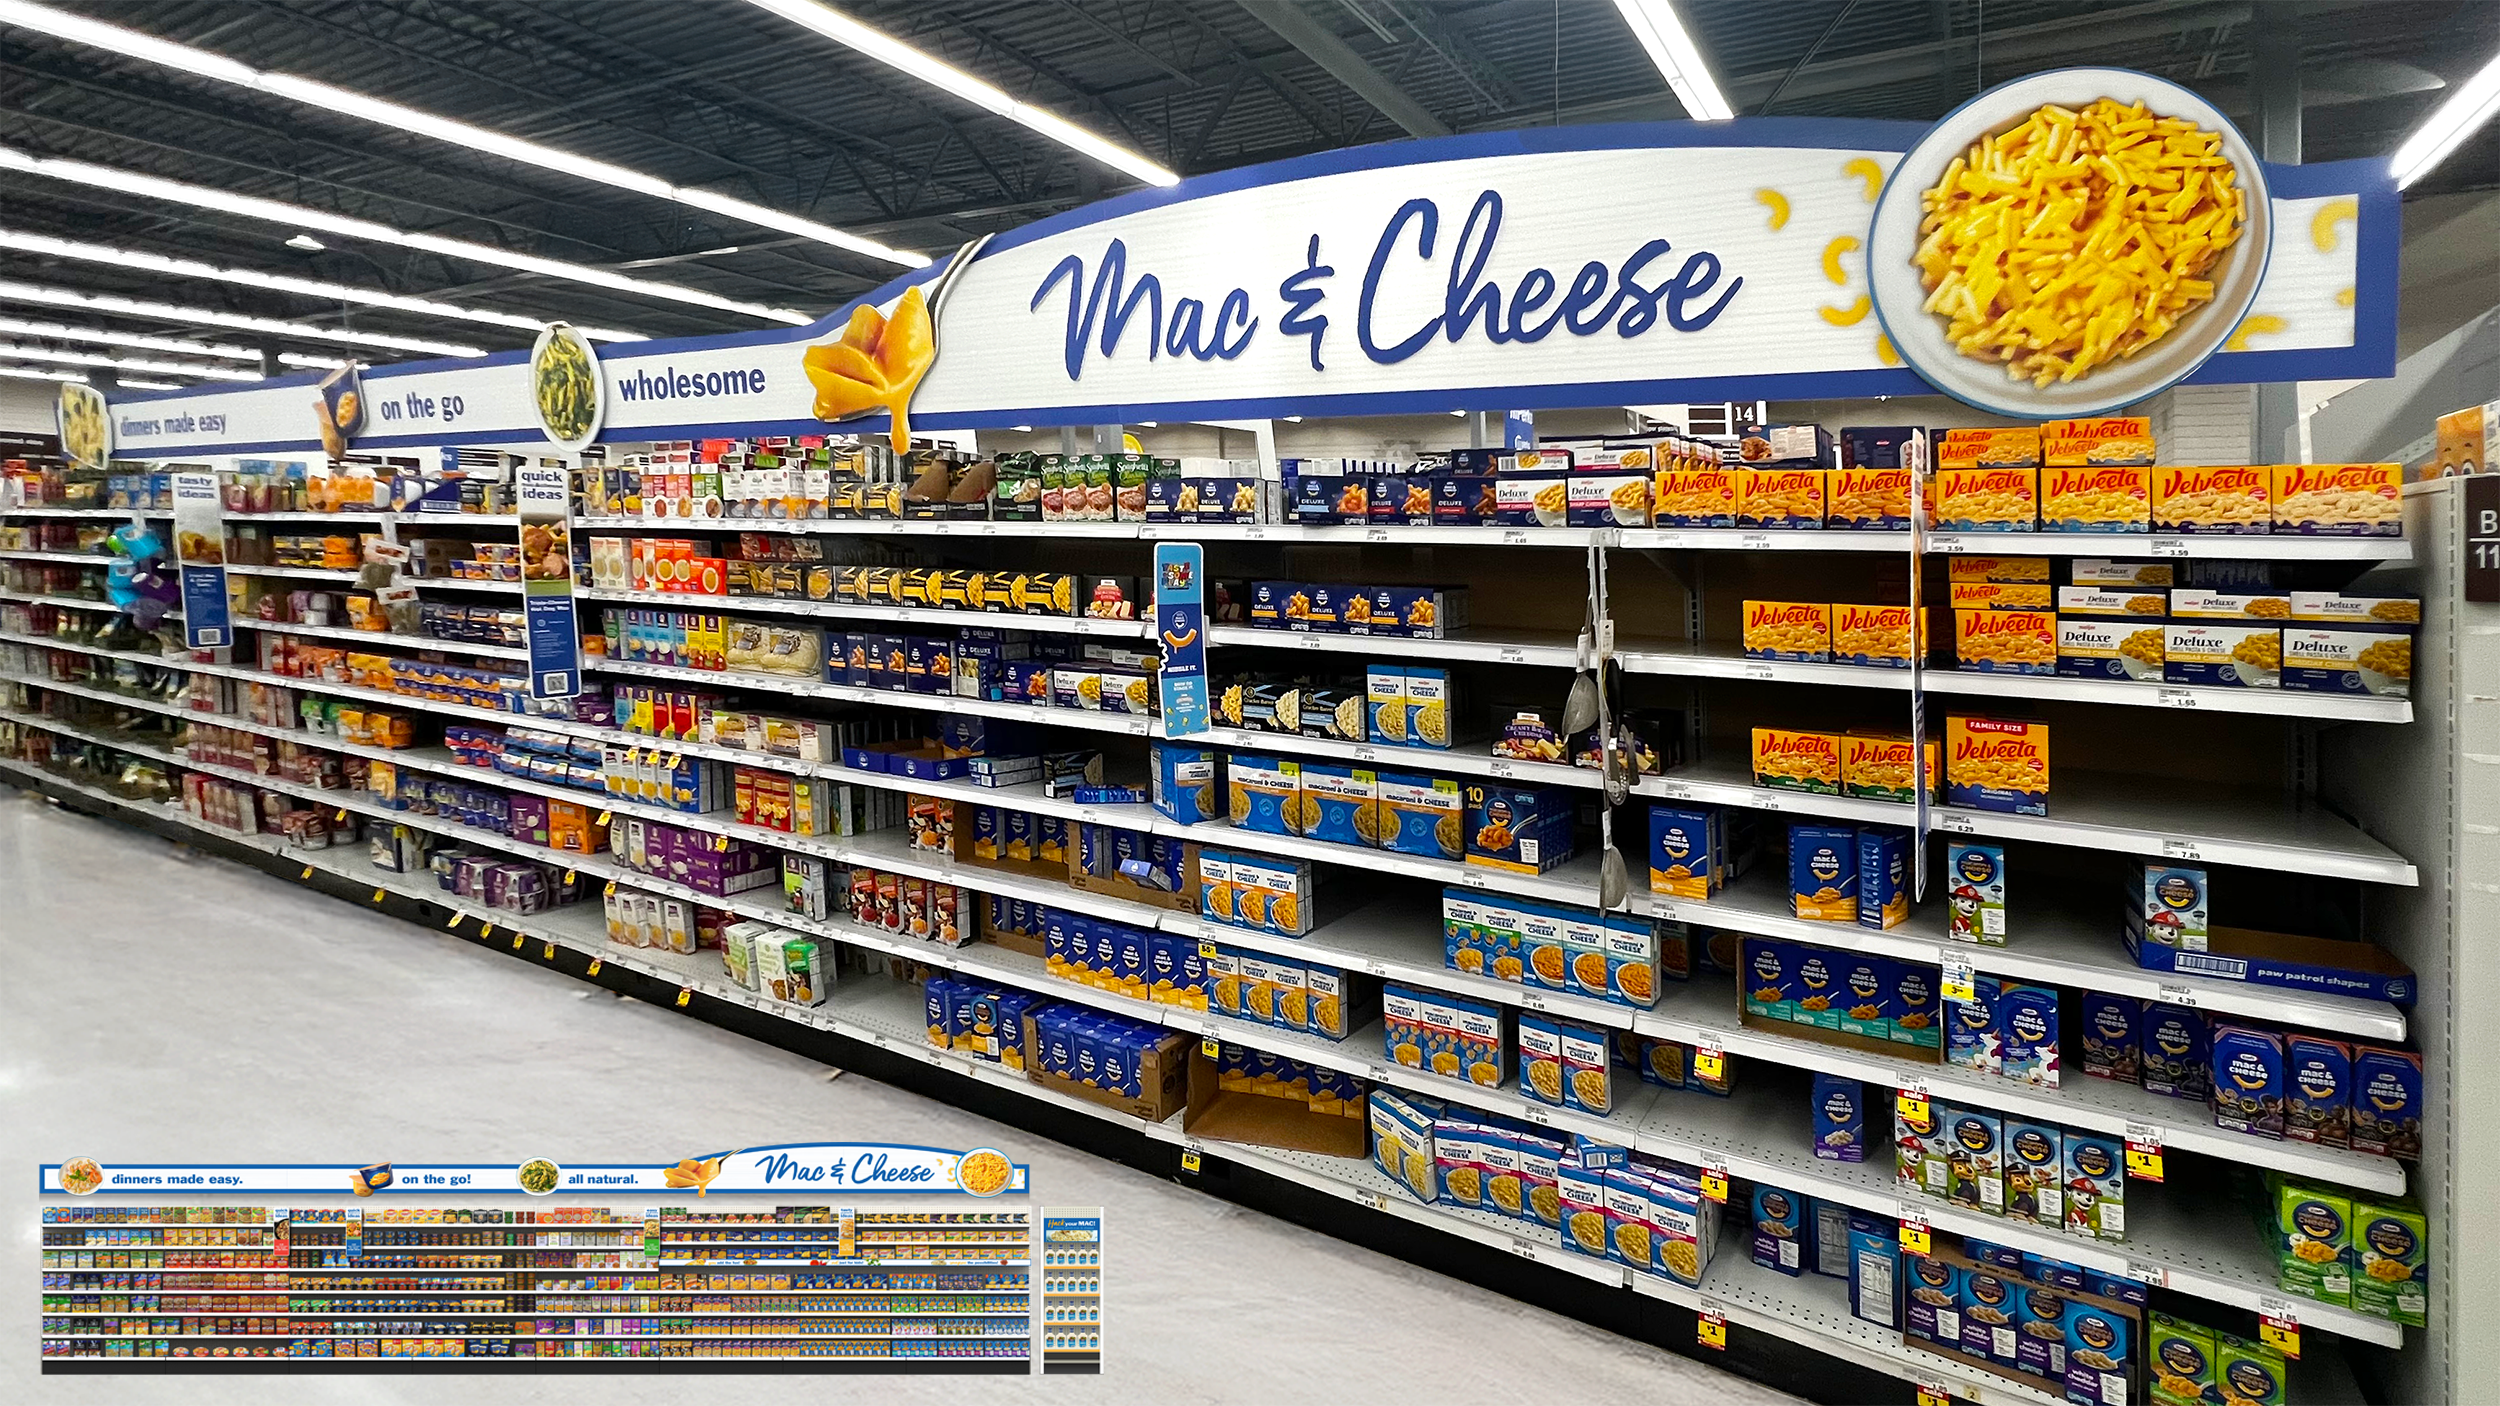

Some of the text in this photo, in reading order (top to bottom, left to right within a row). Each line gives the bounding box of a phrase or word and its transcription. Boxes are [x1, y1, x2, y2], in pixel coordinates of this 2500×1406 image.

[1030, 189, 1744, 381] Mac & Cheese
[618, 366, 766, 402] wholesome
[381, 391, 464, 422] on the go
[1735, 406, 1754, 422] 14
[121, 411, 226, 436] dinners made easy
[2061, 419, 2139, 438] Velveeta
[1941, 444, 1989, 460] Velveeta
[2049, 440, 2099, 457] Velveeta
[178, 476, 212, 486] tasty
[521, 471, 563, 483] quick
[2051, 468, 2140, 498] Velveeta
[2163, 467, 2259, 499] Velveeta
[2283, 465, 2387, 497] Velveeta
[1663, 472, 1728, 497] Velveeta
[1745, 472, 1815, 497] Velveeta
[1836, 470, 1912, 498] Velveeta
[1945, 470, 2025, 498] Velveeta
[178, 490, 215, 499] ideas
[522, 487, 563, 500] ideas
[1498, 489, 1529, 498] Deluxe
[1571, 487, 1605, 496] Deluxe
[2480, 510, 2498, 535] B
[1952, 559, 2000, 575] Velveeta
[2099, 567, 2129, 575] Deluxe
[1954, 584, 2001, 600] Velveeta
[2087, 595, 2119, 604] Deluxe
[2203, 598, 2237, 607] Deluxe
[2324, 601, 2361, 610] Deluxe
[1751, 604, 1821, 628] Velveeta
[1965, 612, 2046, 638] Velveeta
[2064, 631, 2112, 644] Deluxe
[2173, 635, 2223, 648] Deluxe
[2292, 640, 2348, 654] Deluxe
[1373, 686, 1397, 694] CHEESE
[1412, 689, 1436, 698] CHEESE
[1970, 721, 2022, 732] FAMILY SIZE
[1761, 733, 1831, 756] Velveeta
[1956, 736, 2037, 761] Velveeta
[1269, 780, 1294, 790] CHEESE
[1343, 787, 1368, 797] CHEESE
[1465, 786, 1484, 803] 10
[1424, 798, 1451, 809] CHEESE
[1957, 825, 1974, 833] 6.29
[2182, 851, 2201, 860] 7.89
[1450, 912, 1475, 921] CHEESE
[1488, 918, 1514, 929] CHEESE
[1527, 926, 1554, 937] CHEESE
[1570, 934, 1597, 945] CHEESE
[1613, 943, 1642, 955] CHEESE
[2258, 968, 2371, 990] paw patrol shapes
[2177, 996, 2197, 1006] 4.39
[1704, 1059, 1714, 1068] $1
[2232, 1058, 2255, 1070] mac
[2300, 1068, 2323, 1079] mac
[2370, 1080, 2393, 1091] mac
[1904, 1090, 1924, 1101] sale
[1908, 1101, 1920, 1112] $1
[2143, 1137, 2160, 1146] 1.05
[2133, 1143, 2156, 1154] sale
[1443, 1150, 1470, 1160] CHEESE
[2137, 1155, 2152, 1167] $1
[1706, 1169, 1724, 1179] sale
[1709, 1180, 1720, 1191] $1
[1612, 1202, 1640, 1216] CHEESE
[1658, 1218, 1687, 1232] CHEESE
[1904, 1221, 1925, 1232] sale
[1909, 1232, 1921, 1244] $1
[2279, 1311, 2298, 1323] 1.05
[2267, 1317, 2293, 1331] sale
[1707, 1325, 1718, 1336] $1
[2272, 1330, 2288, 1343] $1
[1923, 1387, 1944, 1399] sale
[1969, 1391, 1975, 1400] 2
